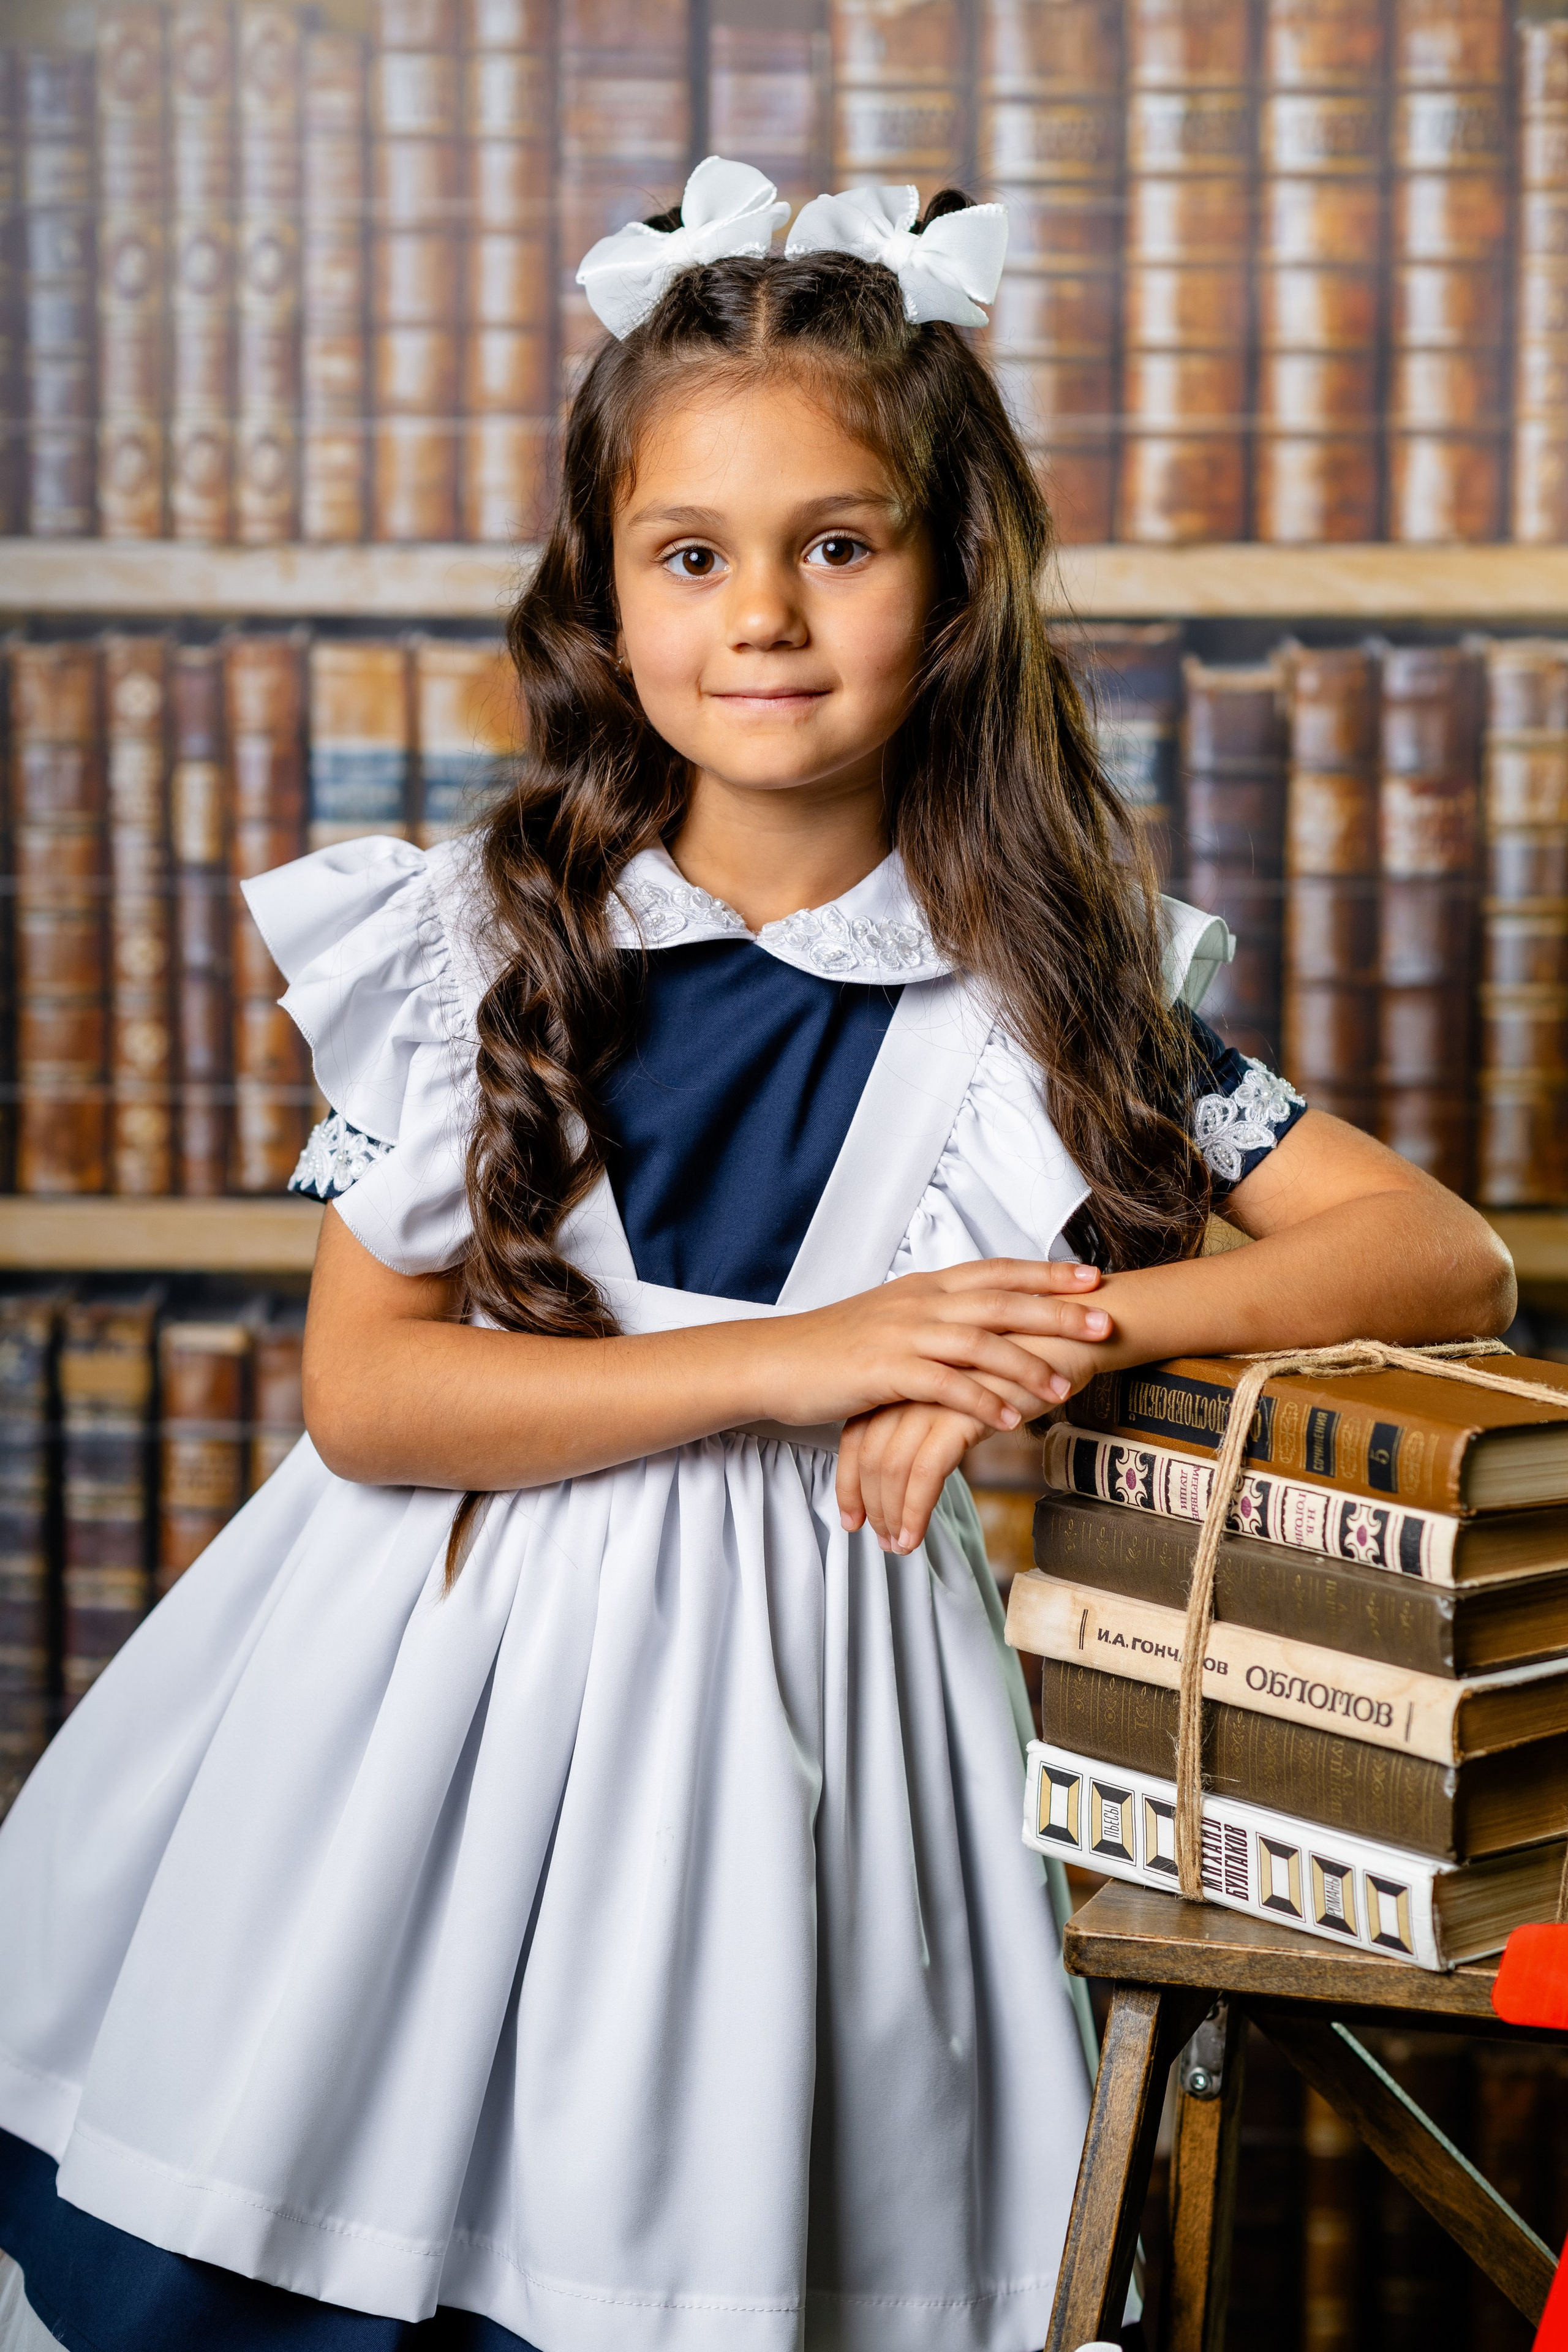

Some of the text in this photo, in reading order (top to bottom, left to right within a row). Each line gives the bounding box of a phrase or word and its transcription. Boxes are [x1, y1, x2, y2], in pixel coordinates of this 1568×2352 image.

[1313, 1411, 1329, 1471] СОЧИНЕНИЯ
[1369, 1449, 1390, 1465] 5
[1191, 1464, 1202, 1520] МЕРТВЫЕ
[1295, 1493, 1307, 1545] ГОГОЛЬ
[1131, 1637, 1229, 1676] ГОНЧОВ
[1246, 1665, 1393, 1727] ОБЛОМОВ
[1104, 1804, 1120, 1838] ПЬЕСЫ
[1201, 1817, 1223, 1893] МИХАИЛ
[1224, 1823, 1250, 1901] БУЛГАКОВ
[1325, 1874, 1342, 1918] РОМАНЫ
